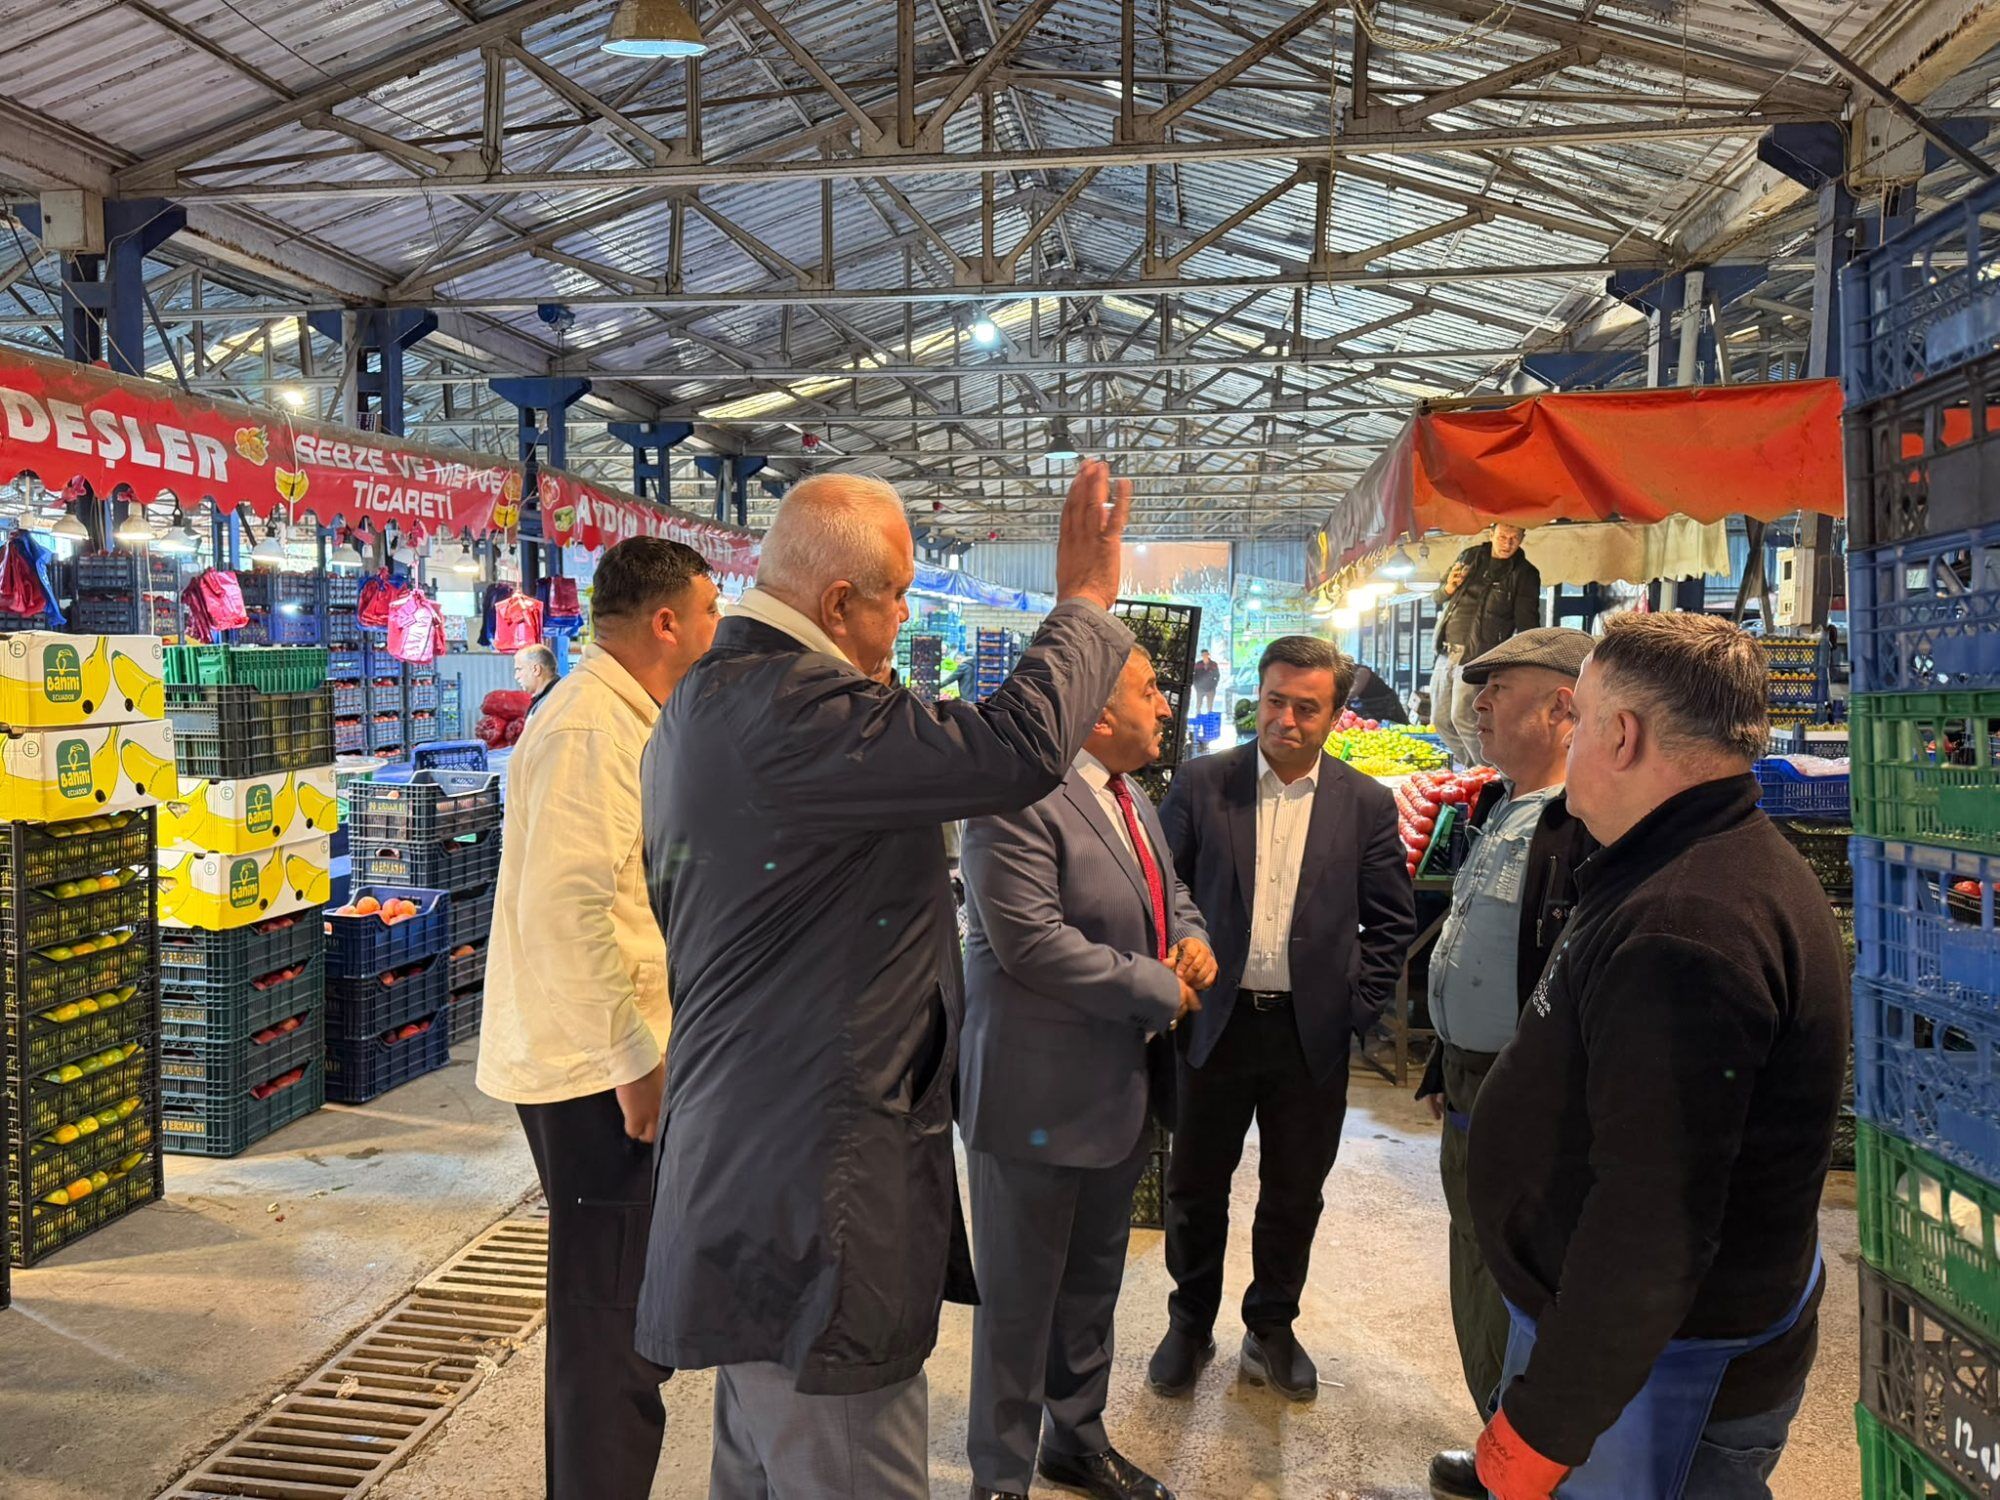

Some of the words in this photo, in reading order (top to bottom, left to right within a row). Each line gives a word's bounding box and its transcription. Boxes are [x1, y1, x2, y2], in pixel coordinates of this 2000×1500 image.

[0, 386, 229, 483] DEŞLER
[295, 434, 389, 476] SEBZE
[391, 452, 428, 482] VE
[433, 459, 506, 495] MEYVE
[352, 476, 454, 520] TİCARETİ
[46, 675, 80, 692] Banini
[52, 693, 75, 701] ECUADOR
[60, 769, 91, 788] Banini
[67, 787, 88, 797] ECUADOR
[231, 882, 258, 900] Banini
